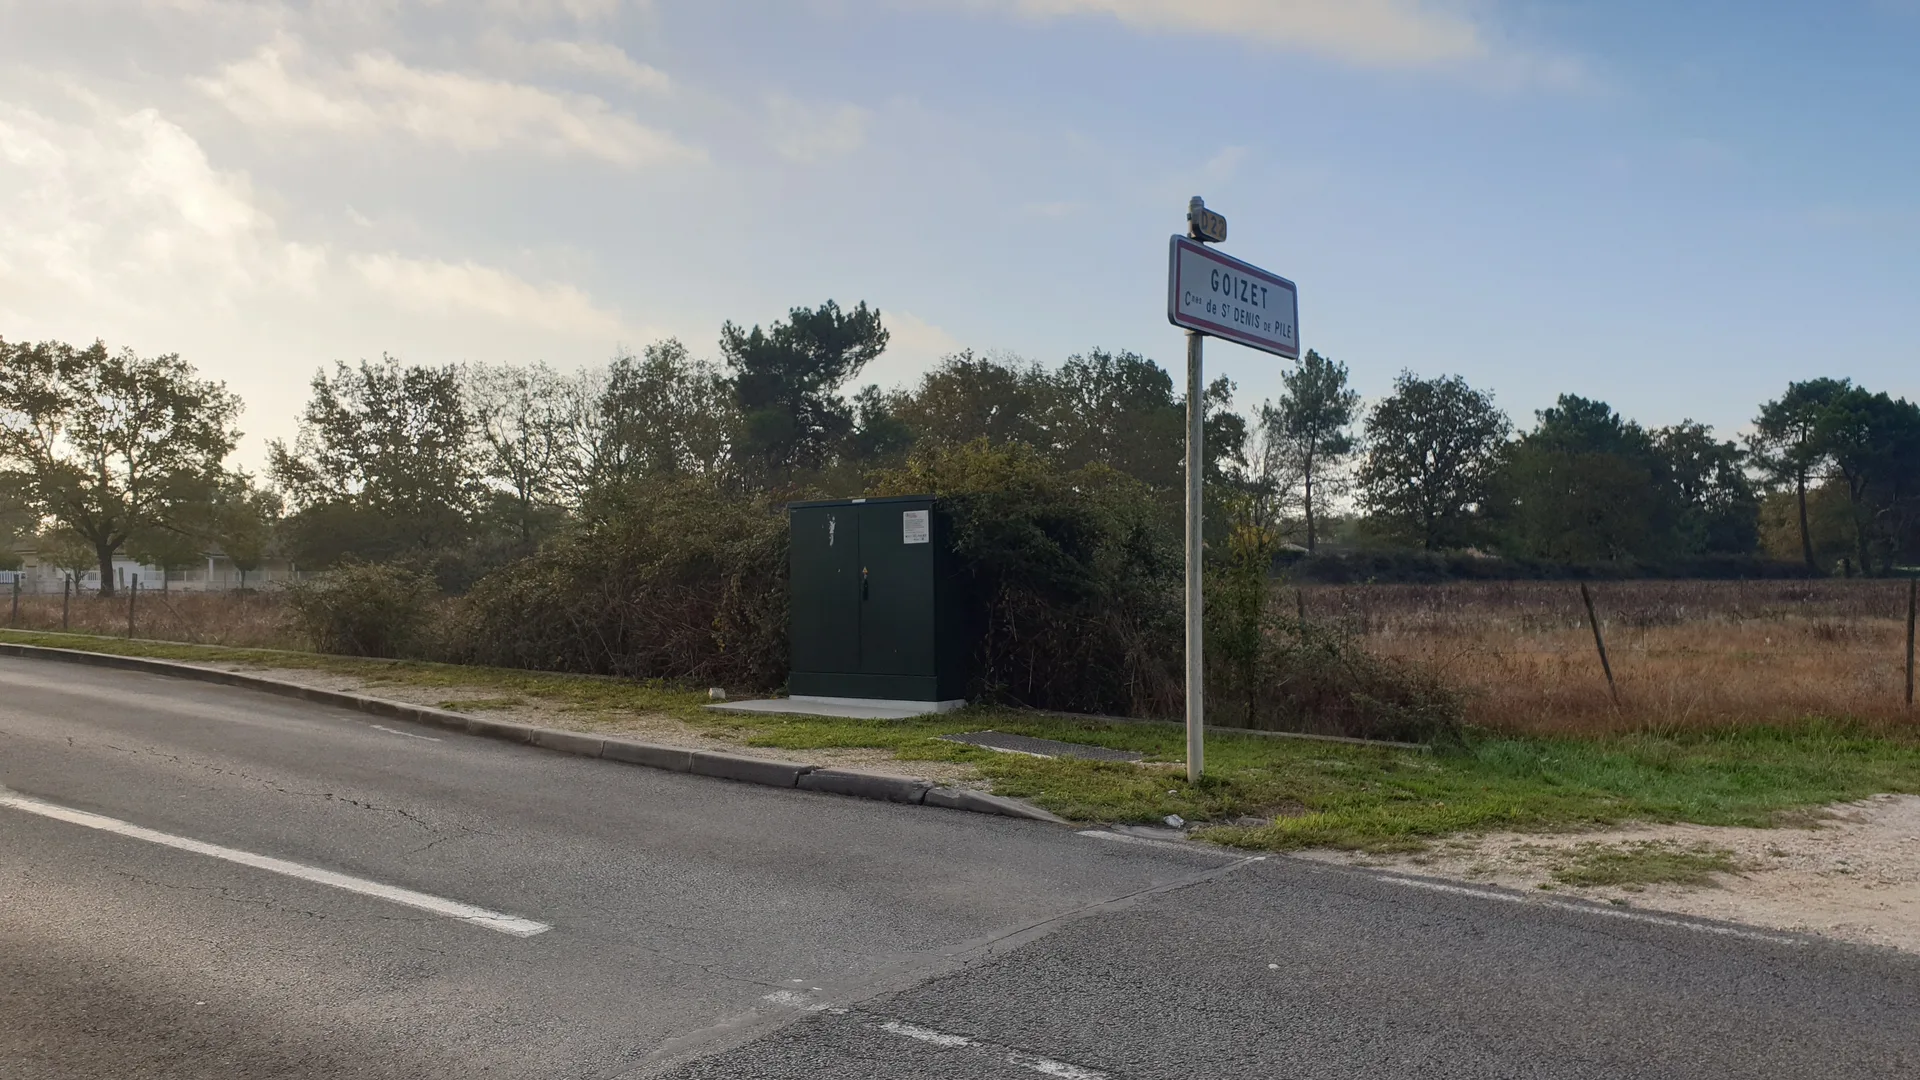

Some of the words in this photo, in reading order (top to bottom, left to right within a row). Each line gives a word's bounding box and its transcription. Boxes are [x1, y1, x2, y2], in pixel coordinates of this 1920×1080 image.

[1211, 268, 1268, 309] GOIZET
[1206, 299, 1217, 315] de
[1233, 307, 1260, 329] DENIS
[1263, 321, 1271, 333] DE
[1274, 320, 1291, 339] PILE
